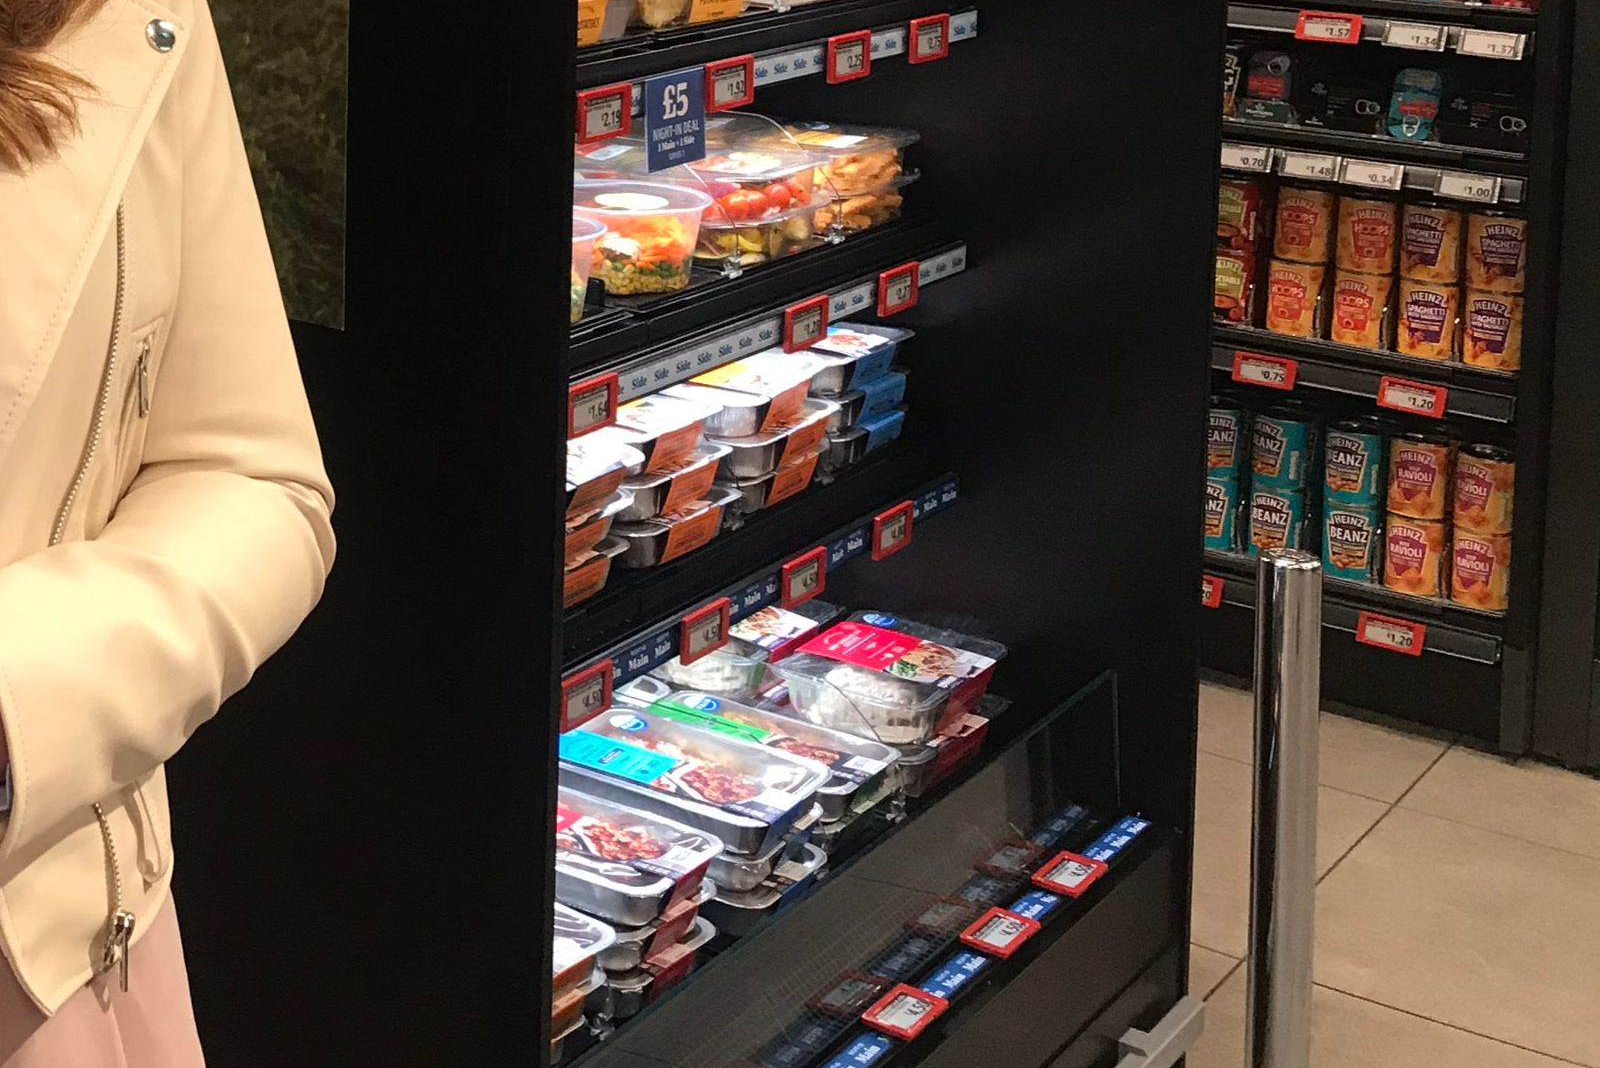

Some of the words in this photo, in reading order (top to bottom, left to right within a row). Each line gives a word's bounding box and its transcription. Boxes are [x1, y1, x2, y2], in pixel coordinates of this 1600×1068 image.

[1325, 26, 1350, 37] £1.57
[1411, 35, 1437, 46] £1.34
[1487, 43, 1514, 54] £1.37
[773, 61, 788, 75] Side
[662, 81, 690, 121] £5
[652, 121, 683, 143] NIGHT-IN
[683, 118, 700, 134] DEAL
[1240, 157, 1264, 168] £0.70
[1306, 165, 1331, 176] £1.48
[1463, 186, 1490, 198] £1.00
[1285, 197, 1315, 209] HEINZ
[1282, 211, 1317, 225] HOOPS
[1357, 209, 1388, 219] HEINZ
[1409, 214, 1441, 228] HEINZ
[1354, 224, 1390, 236] HOOPS
[1486, 226, 1520, 238] HEINZ
[1481, 238, 1520, 249] SPAGHETTI
[1273, 270, 1303, 283] HEINZ
[1271, 284, 1304, 298] HOOPS
[1338, 281, 1369, 293] HEINZ
[1336, 295, 1370, 308] HOOPS
[1411, 292, 1444, 305] HEINZ
[1407, 303, 1446, 316] SPAGHETTI
[1474, 300, 1507, 313] HEINZ
[1470, 313, 1510, 326] SPAGHETTI
[631, 376, 648, 391] Side
[653, 367, 670, 382] Side
[675, 359, 692, 374] Side
[697, 351, 713, 366] Side
[717, 343, 733, 358] Side
[1260, 369, 1285, 383] £0.75
[1407, 395, 1434, 409] £1.20
[1329, 435, 1360, 451] HEINZ
[1327, 448, 1363, 468] BEANZ
[1399, 451, 1432, 464] HEINZ
[1398, 467, 1433, 482] RAVIOLI
[1256, 496, 1285, 511] HEINZ
[1252, 507, 1288, 526] BEANZ
[1334, 513, 1365, 527] HEINZ
[1330, 526, 1369, 544] BEANZ
[1391, 525, 1422, 541] HEINZ
[1389, 543, 1423, 559] RAVIOLI
[1458, 540, 1489, 555] HEINZ
[1456, 556, 1490, 571] RAVIOLI
[627, 654, 649, 673] Main
[653, 640, 671, 658] Main
[743, 590, 761, 608] Main
[1386, 632, 1413, 647] £1.20
[962, 954, 987, 971] Main
[941, 972, 967, 991] Main
[854, 1044, 881, 1065] Main
